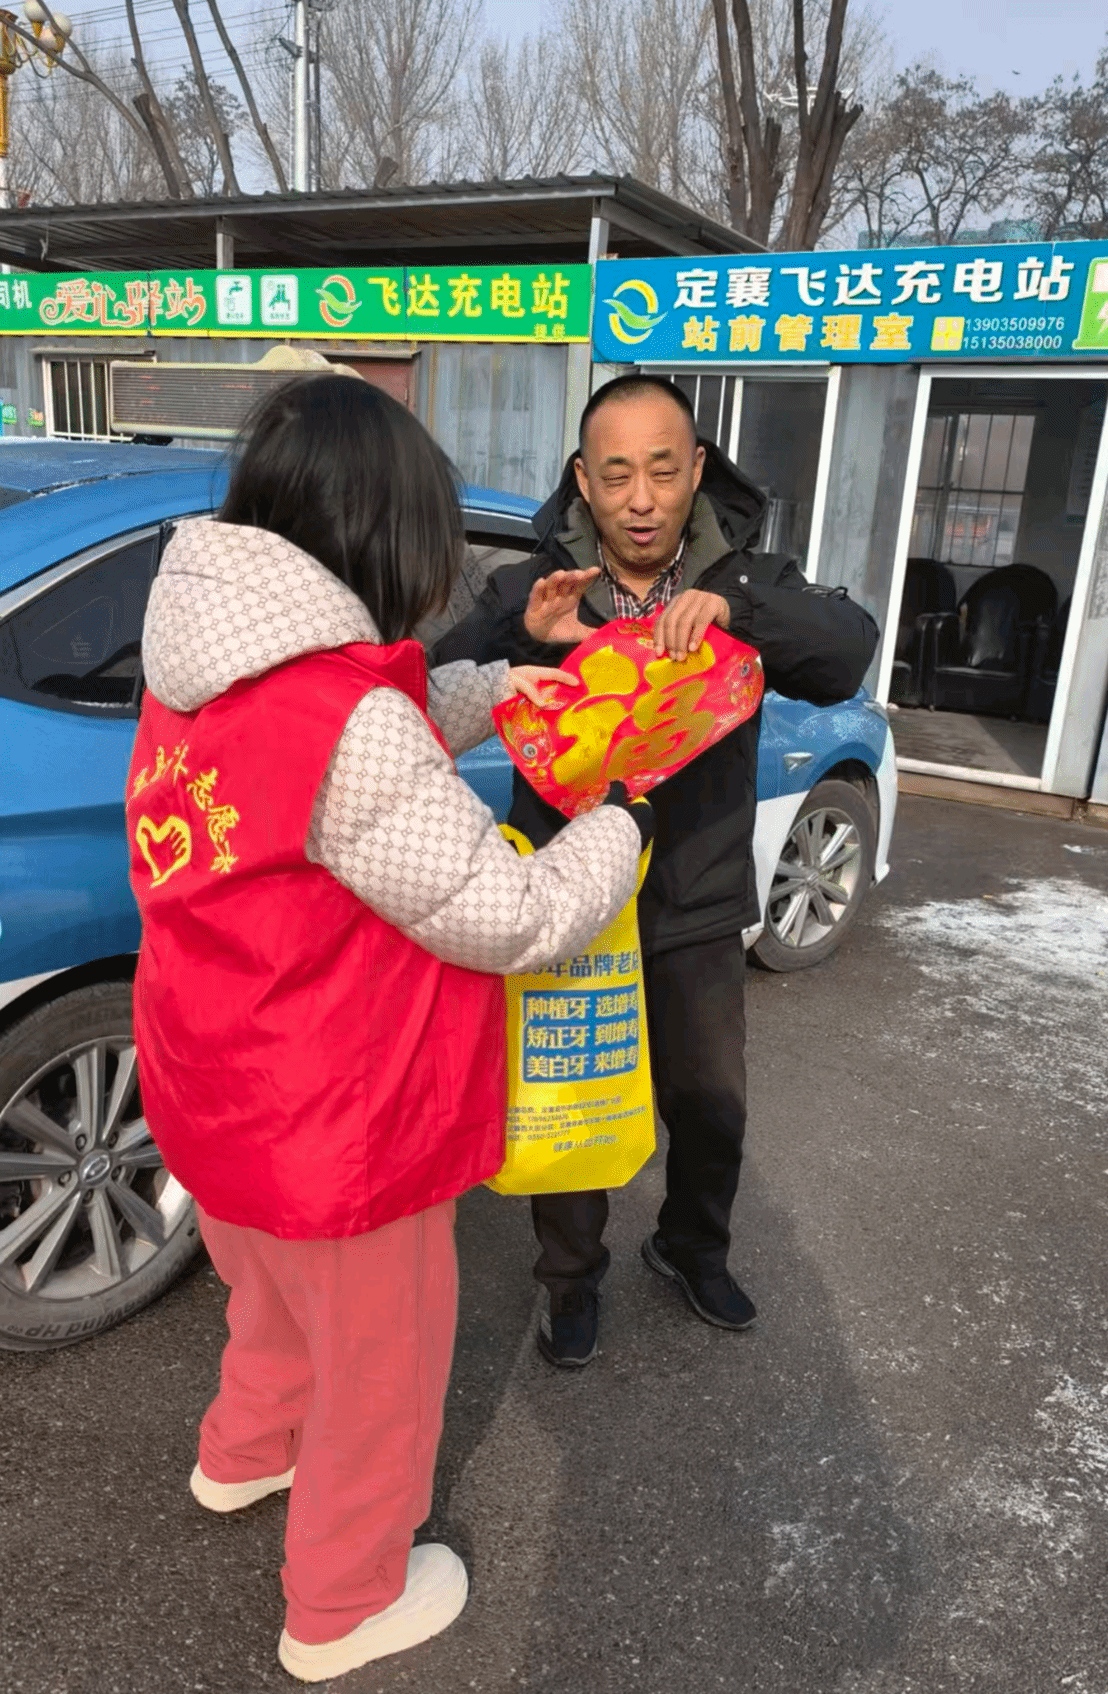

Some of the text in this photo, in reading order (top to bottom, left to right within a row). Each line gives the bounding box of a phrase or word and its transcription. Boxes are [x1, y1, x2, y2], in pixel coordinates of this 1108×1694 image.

[673, 255, 1075, 309] 定襄飞达充电站
[39, 277, 207, 327] 爱心驿站
[367, 272, 571, 319] 飞达充电站
[682, 312, 915, 353] 站前管理室
[965, 317, 1065, 332] 13903509976
[963, 336, 1063, 351] 15135038000
[526, 996, 592, 1021] 种植牙
[526, 1025, 591, 1049] 矫正牙
[526, 1053, 590, 1079] 美白牙
